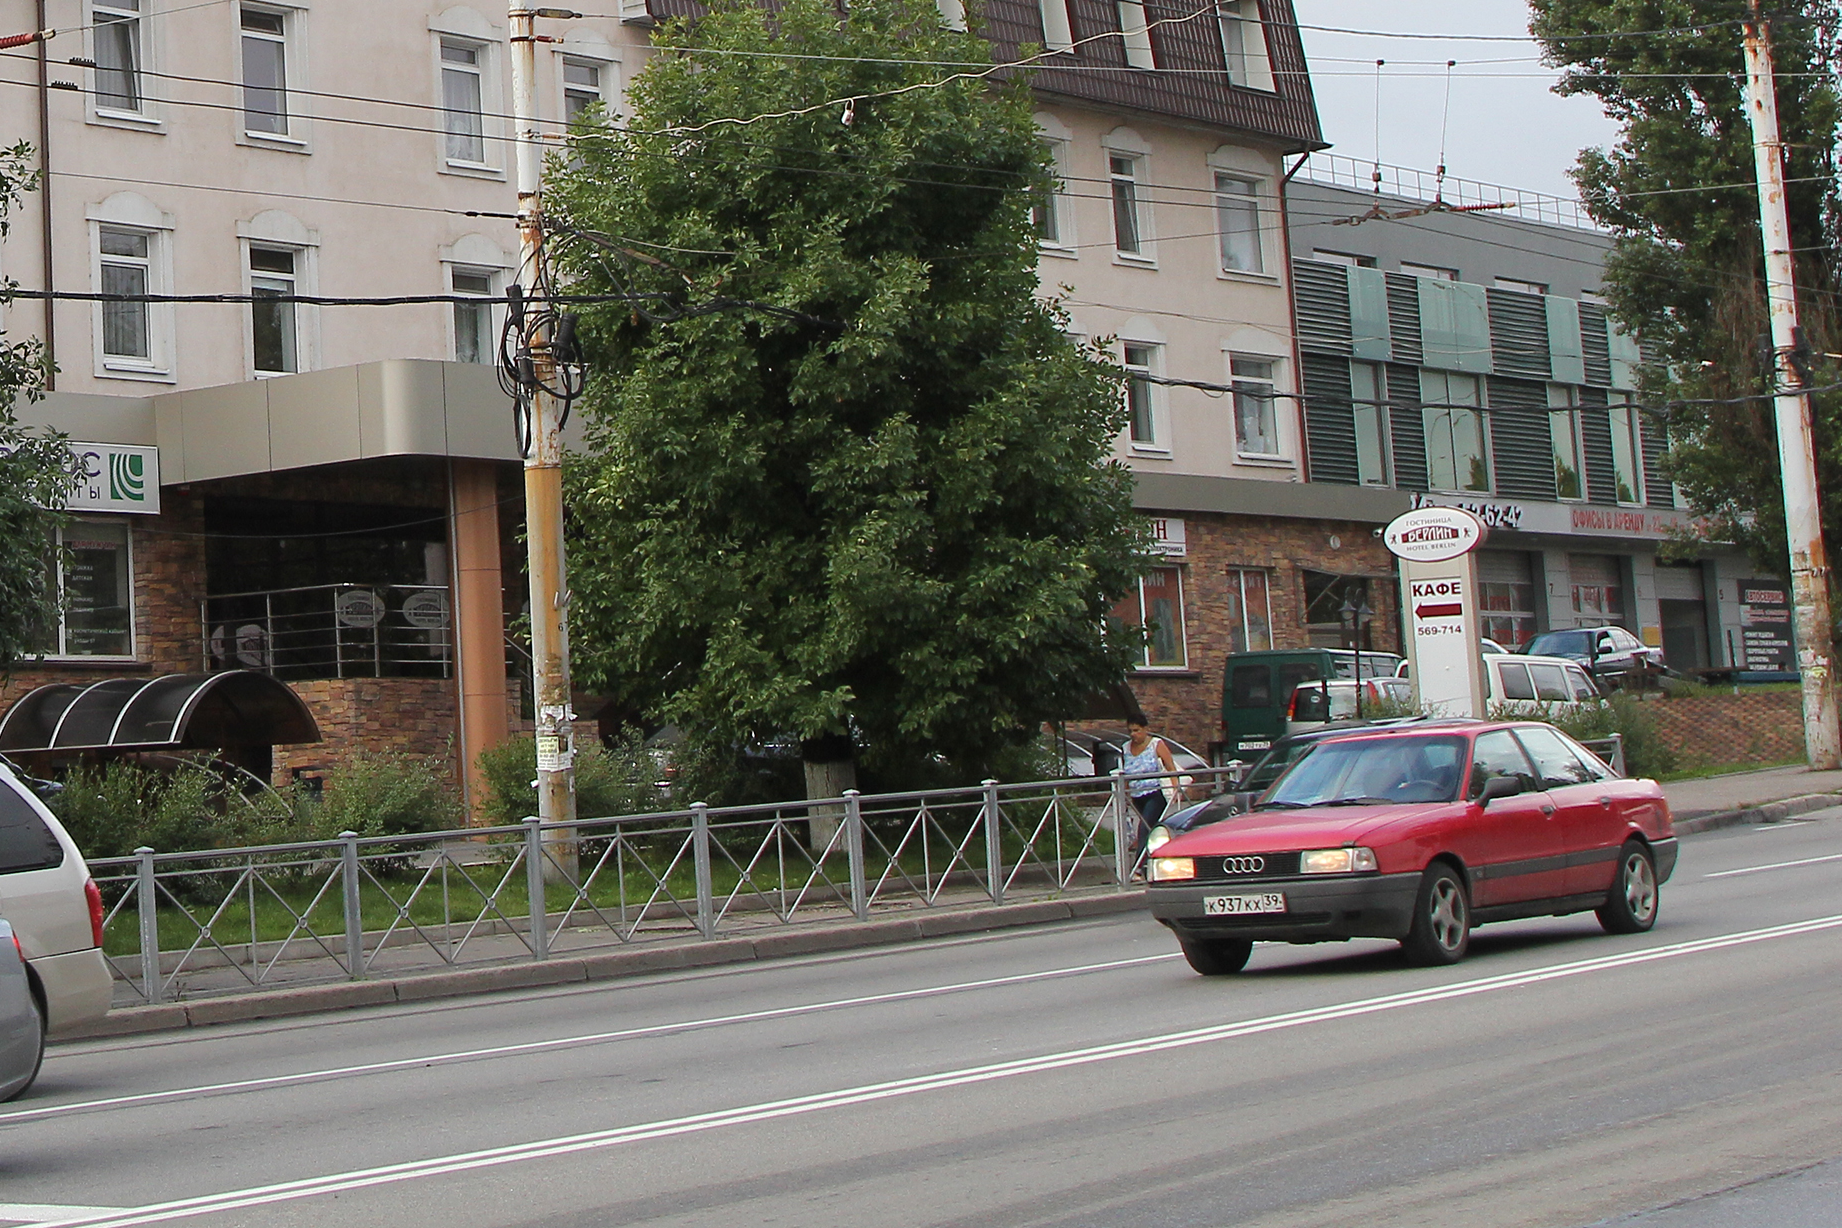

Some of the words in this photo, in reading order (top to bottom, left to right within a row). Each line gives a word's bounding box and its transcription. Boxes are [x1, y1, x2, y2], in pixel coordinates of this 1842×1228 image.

[1406, 517, 1452, 527] ГОСТИНИЦА
[1408, 527, 1453, 542] БЕРЛИН
[1431, 542, 1456, 550] BERLIN
[1412, 582, 1462, 597] КАФЕ
[1418, 625, 1462, 636] 569-714
[1264, 894, 1279, 906] 39
